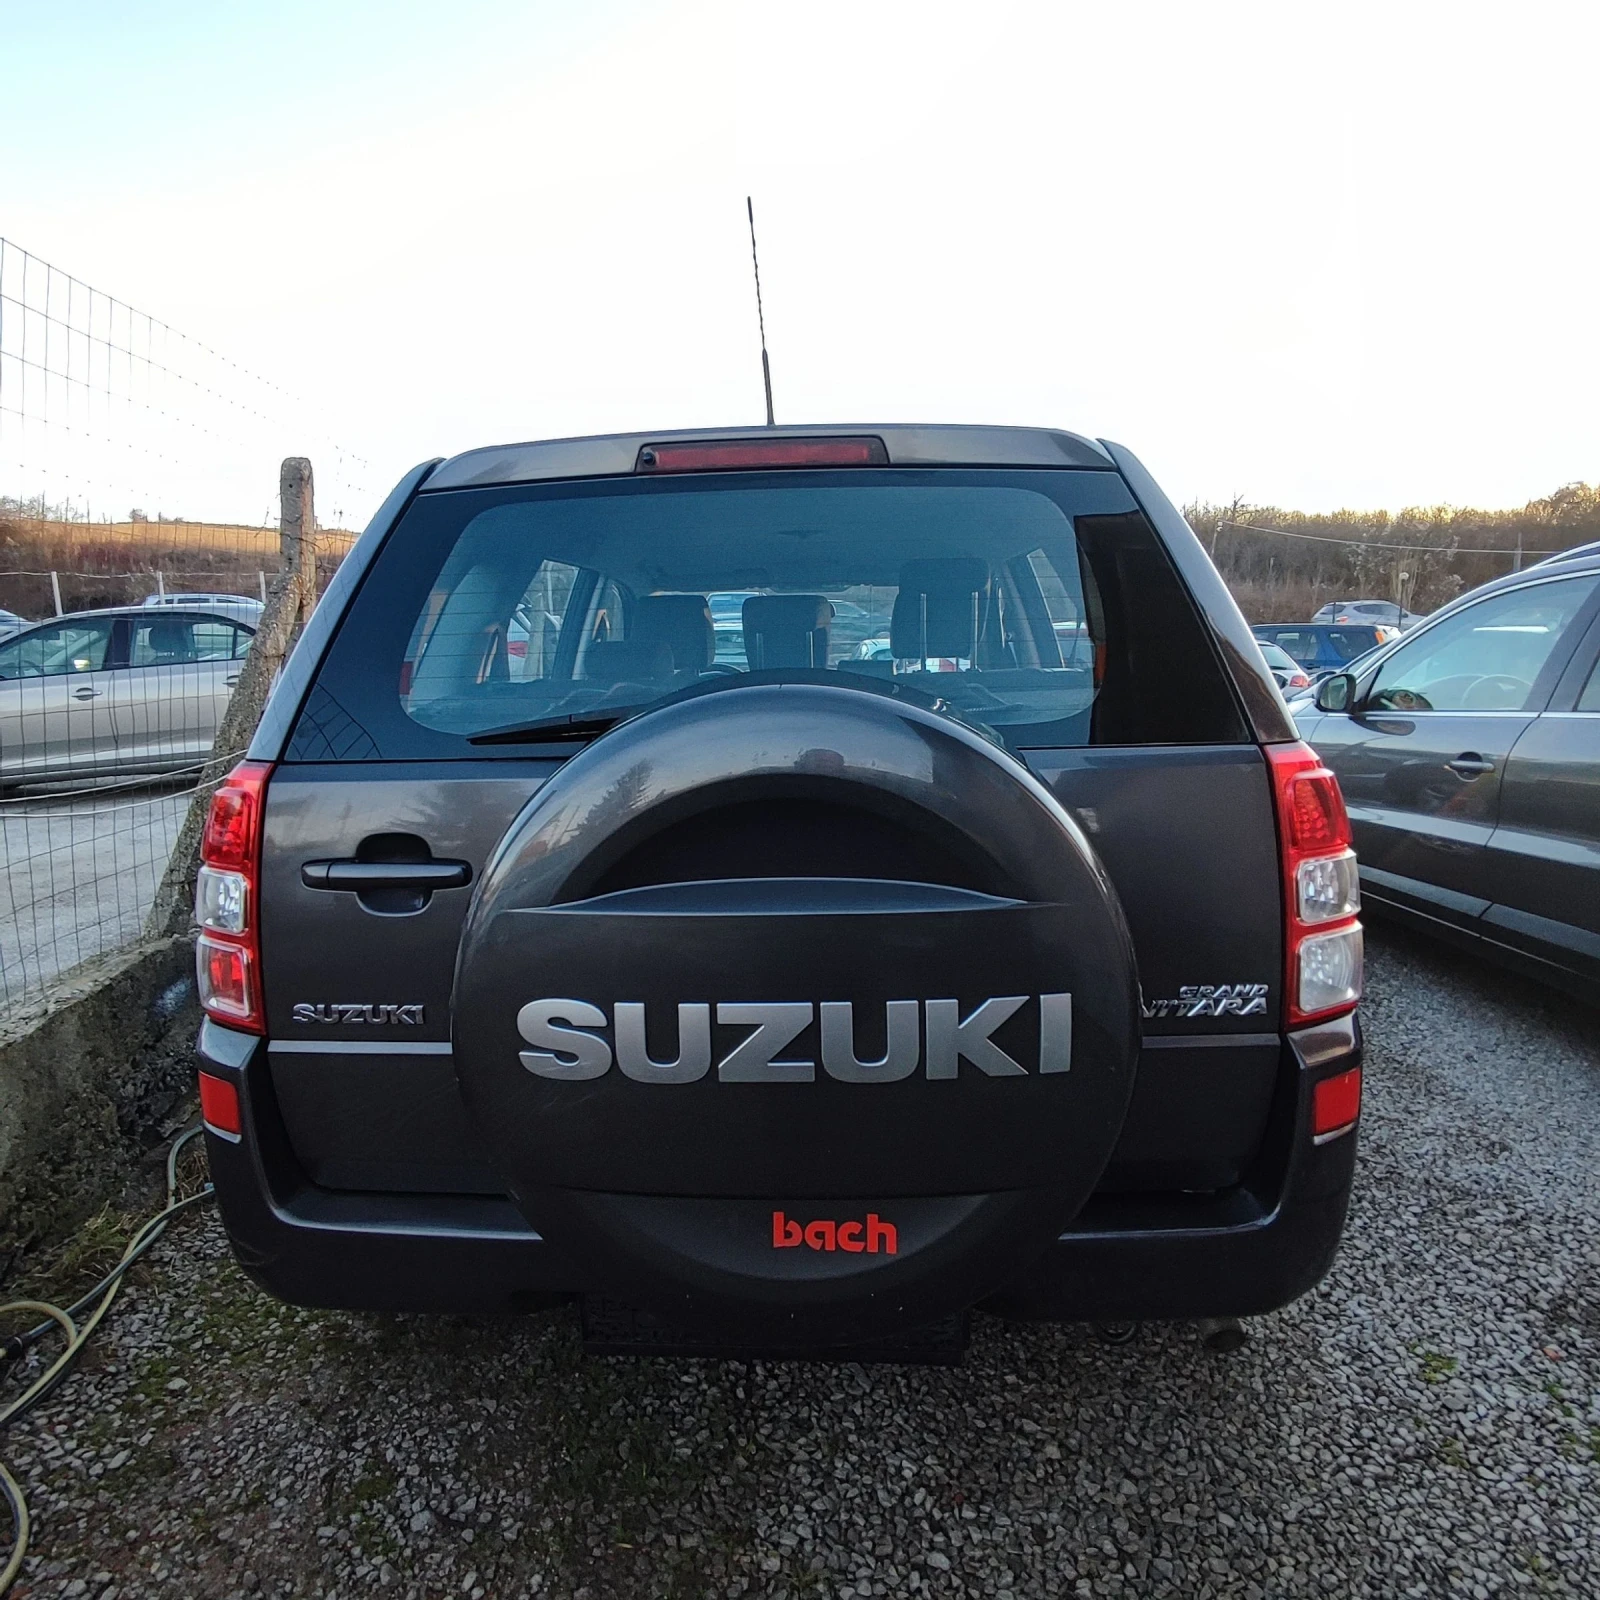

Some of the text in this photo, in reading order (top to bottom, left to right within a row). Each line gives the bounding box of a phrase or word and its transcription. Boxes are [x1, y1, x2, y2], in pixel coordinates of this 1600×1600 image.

[1179, 984, 1269, 998] GRAND
[293, 1003, 424, 1025] SUZUKI
[1142, 997, 1267, 1018] VITARA
[517, 993, 1072, 1084] SUZUKI
[773, 1211, 897, 1254] bach
